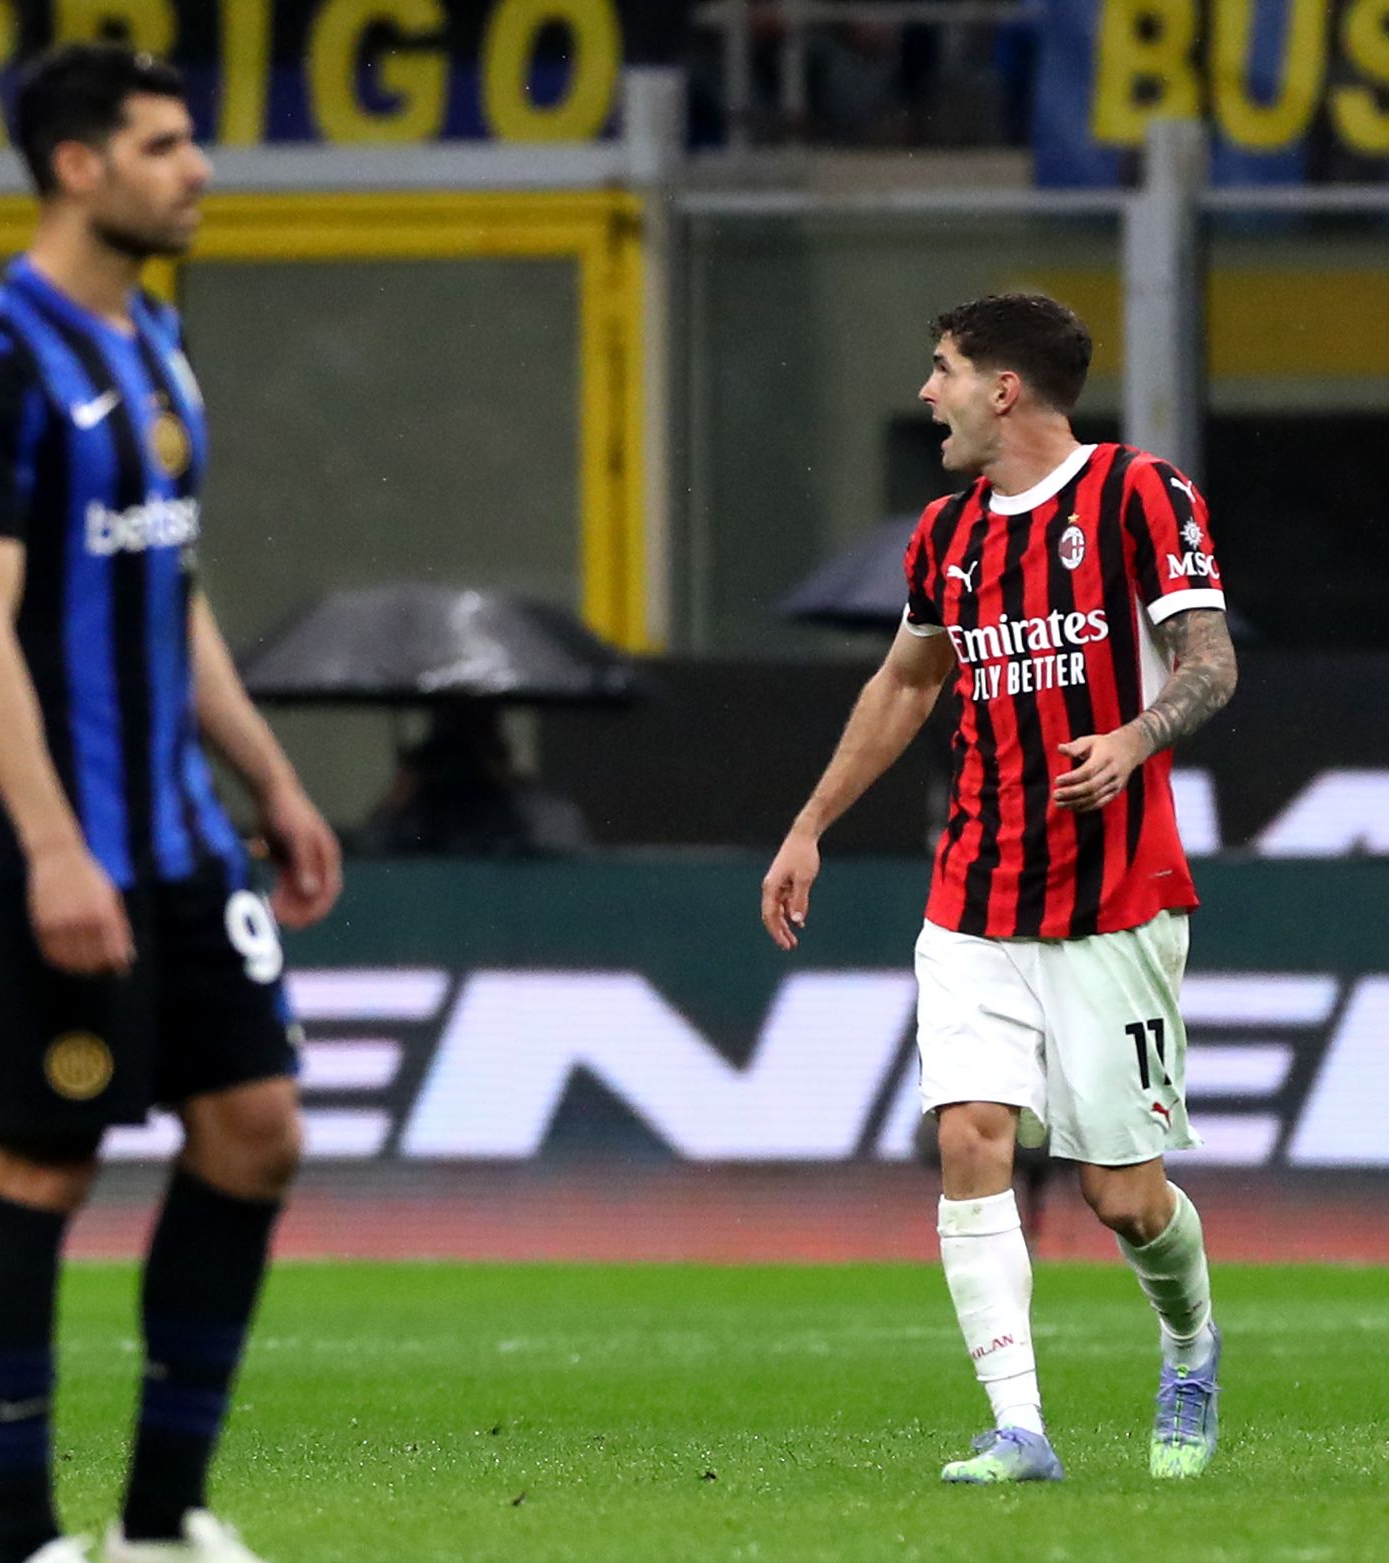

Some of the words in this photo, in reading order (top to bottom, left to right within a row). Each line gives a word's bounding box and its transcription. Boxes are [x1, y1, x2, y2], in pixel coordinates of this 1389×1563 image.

[1167, 552, 1221, 580] MSC
[948, 608, 1110, 664] Emirates
[1008, 652, 1086, 696] BETTER
[225, 890, 284, 984] 9
[1125, 1018, 1173, 1090] 11
